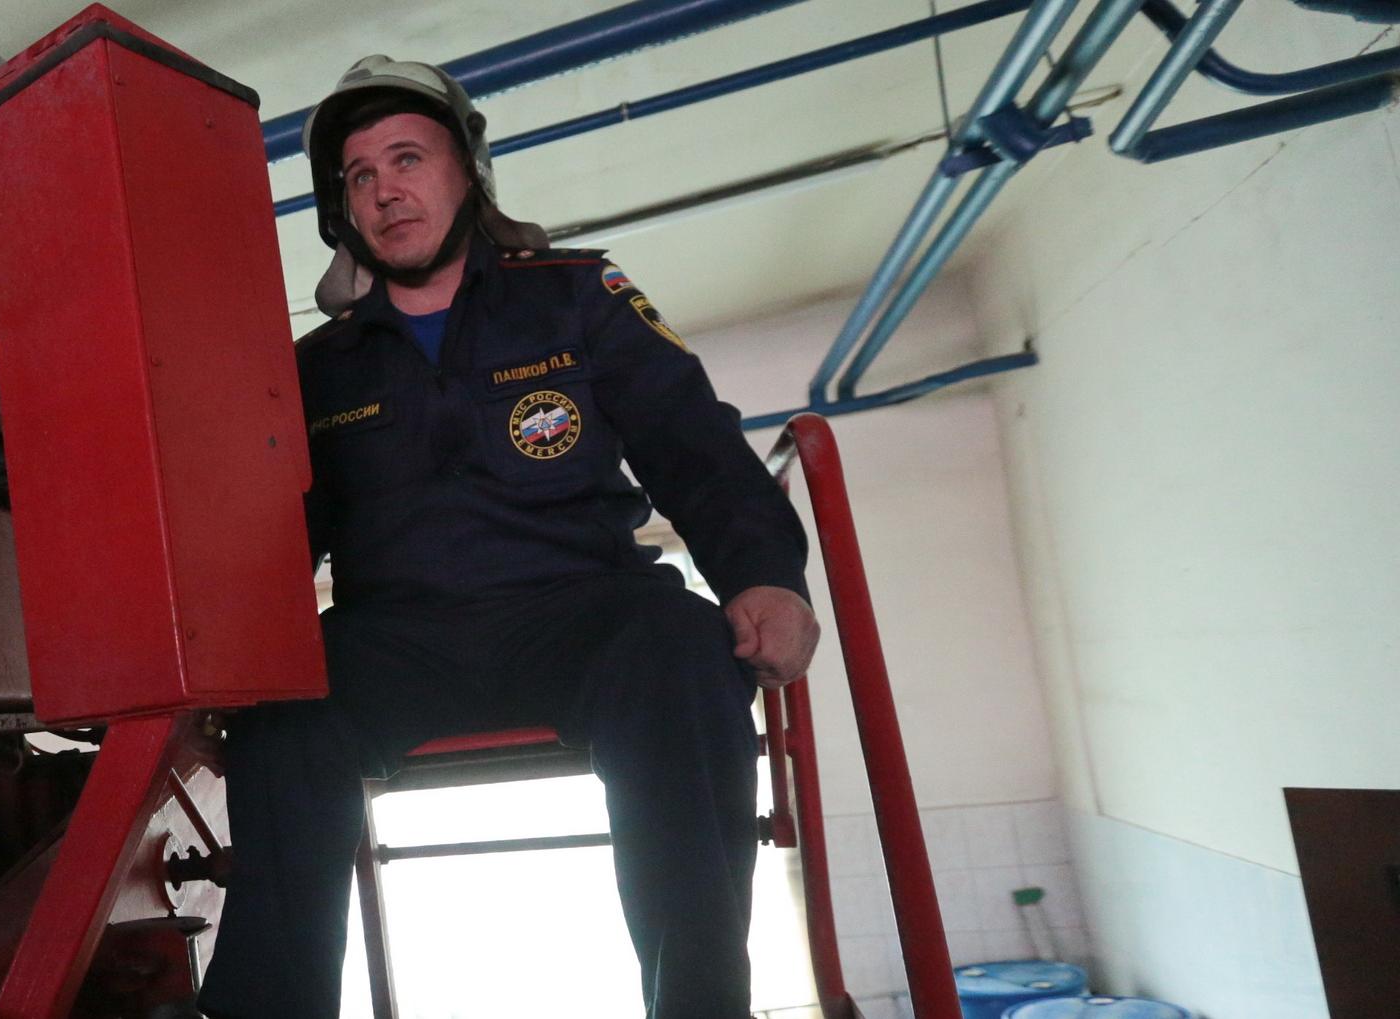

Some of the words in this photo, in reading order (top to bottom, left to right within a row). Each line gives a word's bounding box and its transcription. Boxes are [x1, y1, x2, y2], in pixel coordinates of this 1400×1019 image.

[493, 361, 549, 384] ПАШКОВ
[550, 352, 577, 370] П.В.
[331, 403, 380, 427] РОССИИ
[512, 402, 527, 425] МЧС
[529, 393, 573, 411] РОССИИ
[517, 425, 578, 457] EMERCOM
